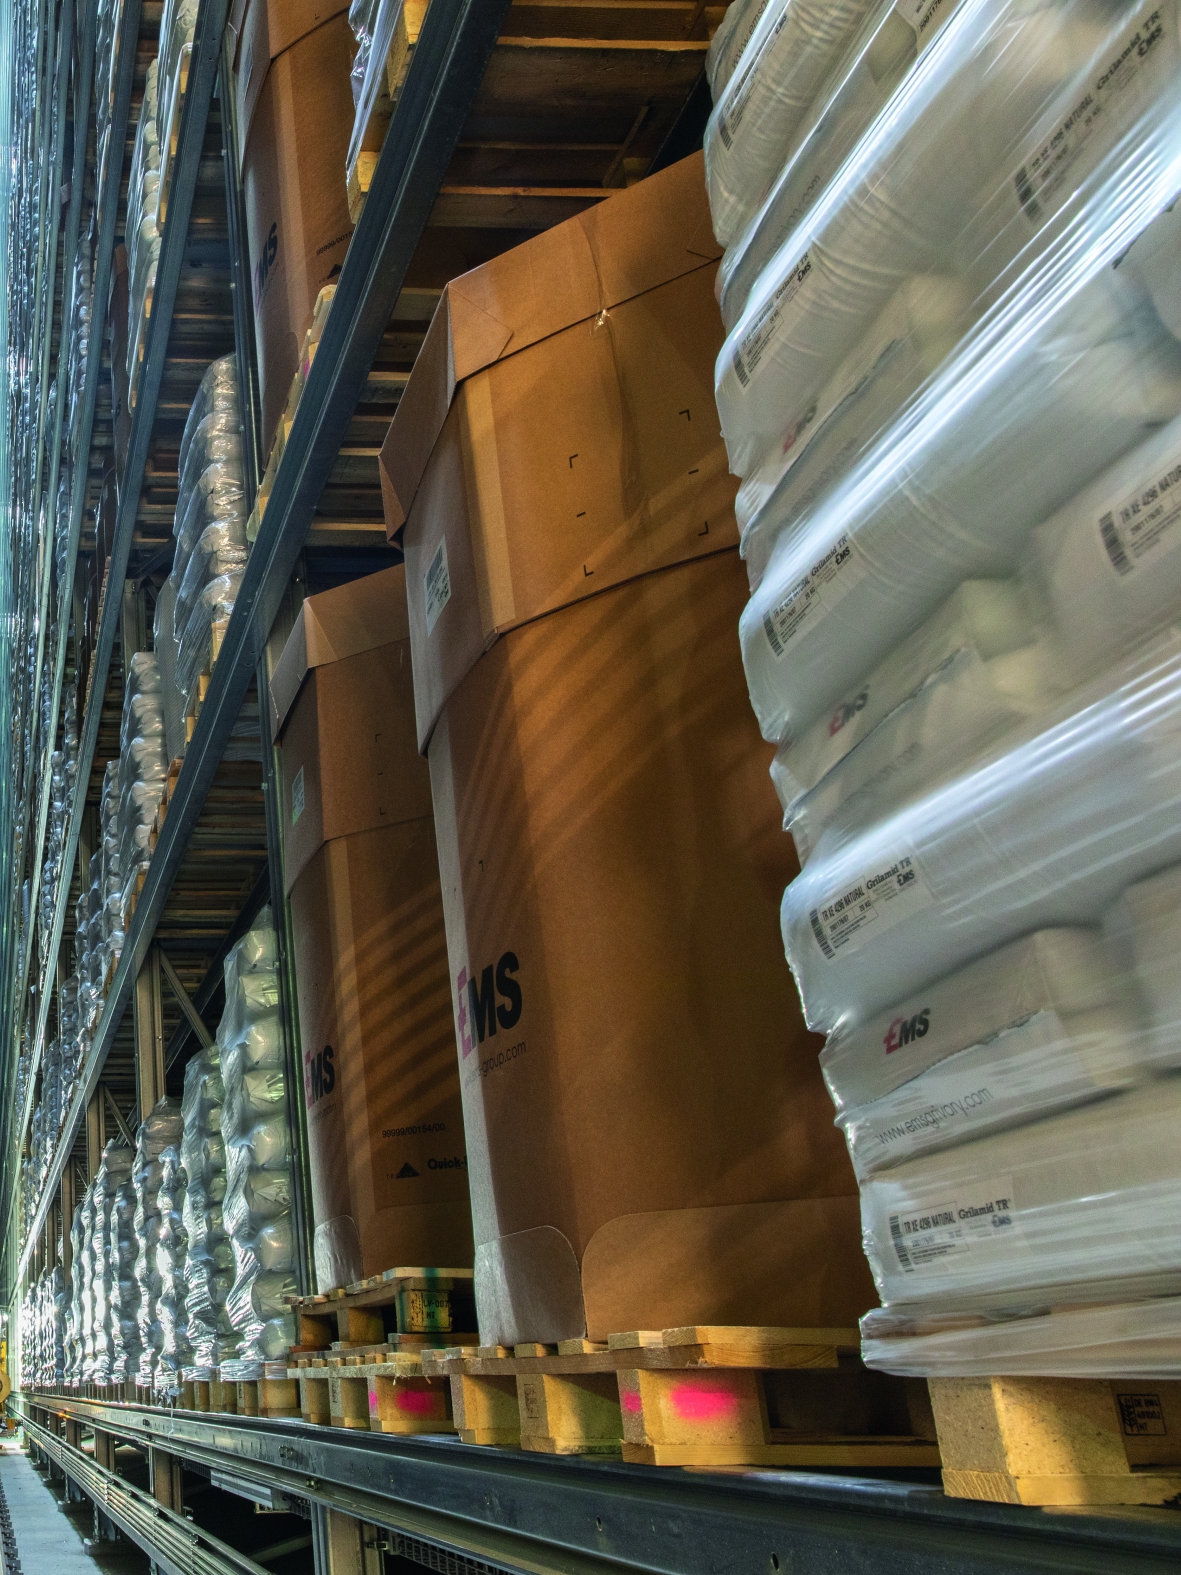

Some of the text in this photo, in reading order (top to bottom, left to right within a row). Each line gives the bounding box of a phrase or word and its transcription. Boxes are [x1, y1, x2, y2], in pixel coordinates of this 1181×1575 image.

[1097, 10, 1160, 90] Grilamid TR
[316, 229, 354, 257] 99999/0015
[797, 261, 812, 283] EMS
[811, 547, 838, 577] Grilamid
[838, 535, 848, 549] TR
[835, 546, 851, 566] EMS
[866, 864, 899, 890] Grilamid
[899, 856, 912, 870] TR
[897, 869, 915, 887] EMS
[822, 910, 830, 922] TR
[828, 905, 835, 918] XE
[834, 898, 846, 914] 4296
[843, 885, 865, 907] NATURAL
[457, 951, 523, 1060] EMS
[883, 1006, 931, 1055] EMS
[304, 1045, 335, 1110] EMS
[382, 1122, 446, 1139] 99999/00154/00
[875, 1087, 994, 1145] www.emsgrivory.com
[904, 1211, 956, 1234] TR XE 4296 NATURAL
[958, 1198, 1010, 1220] Grilamid TR
